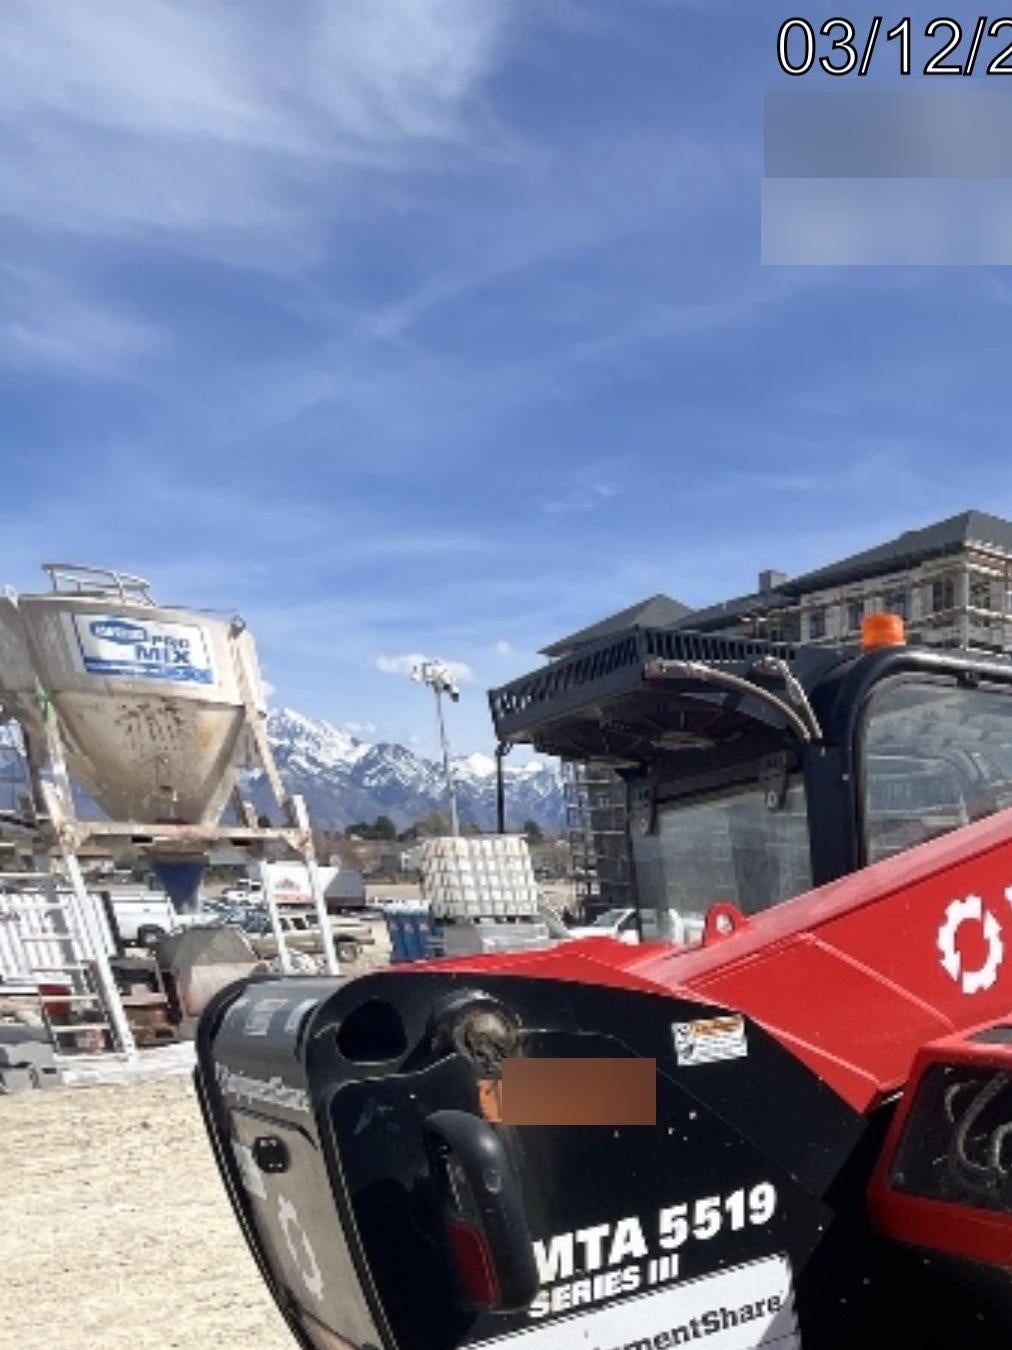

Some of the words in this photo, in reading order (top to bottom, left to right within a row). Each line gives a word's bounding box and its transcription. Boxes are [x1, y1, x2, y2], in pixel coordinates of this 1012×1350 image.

[532, 1214, 649, 1284] MTA
[658, 1181, 777, 1250] 5519
[527, 1264, 640, 1319] SERIES
[649, 1253, 680, 1285] III
